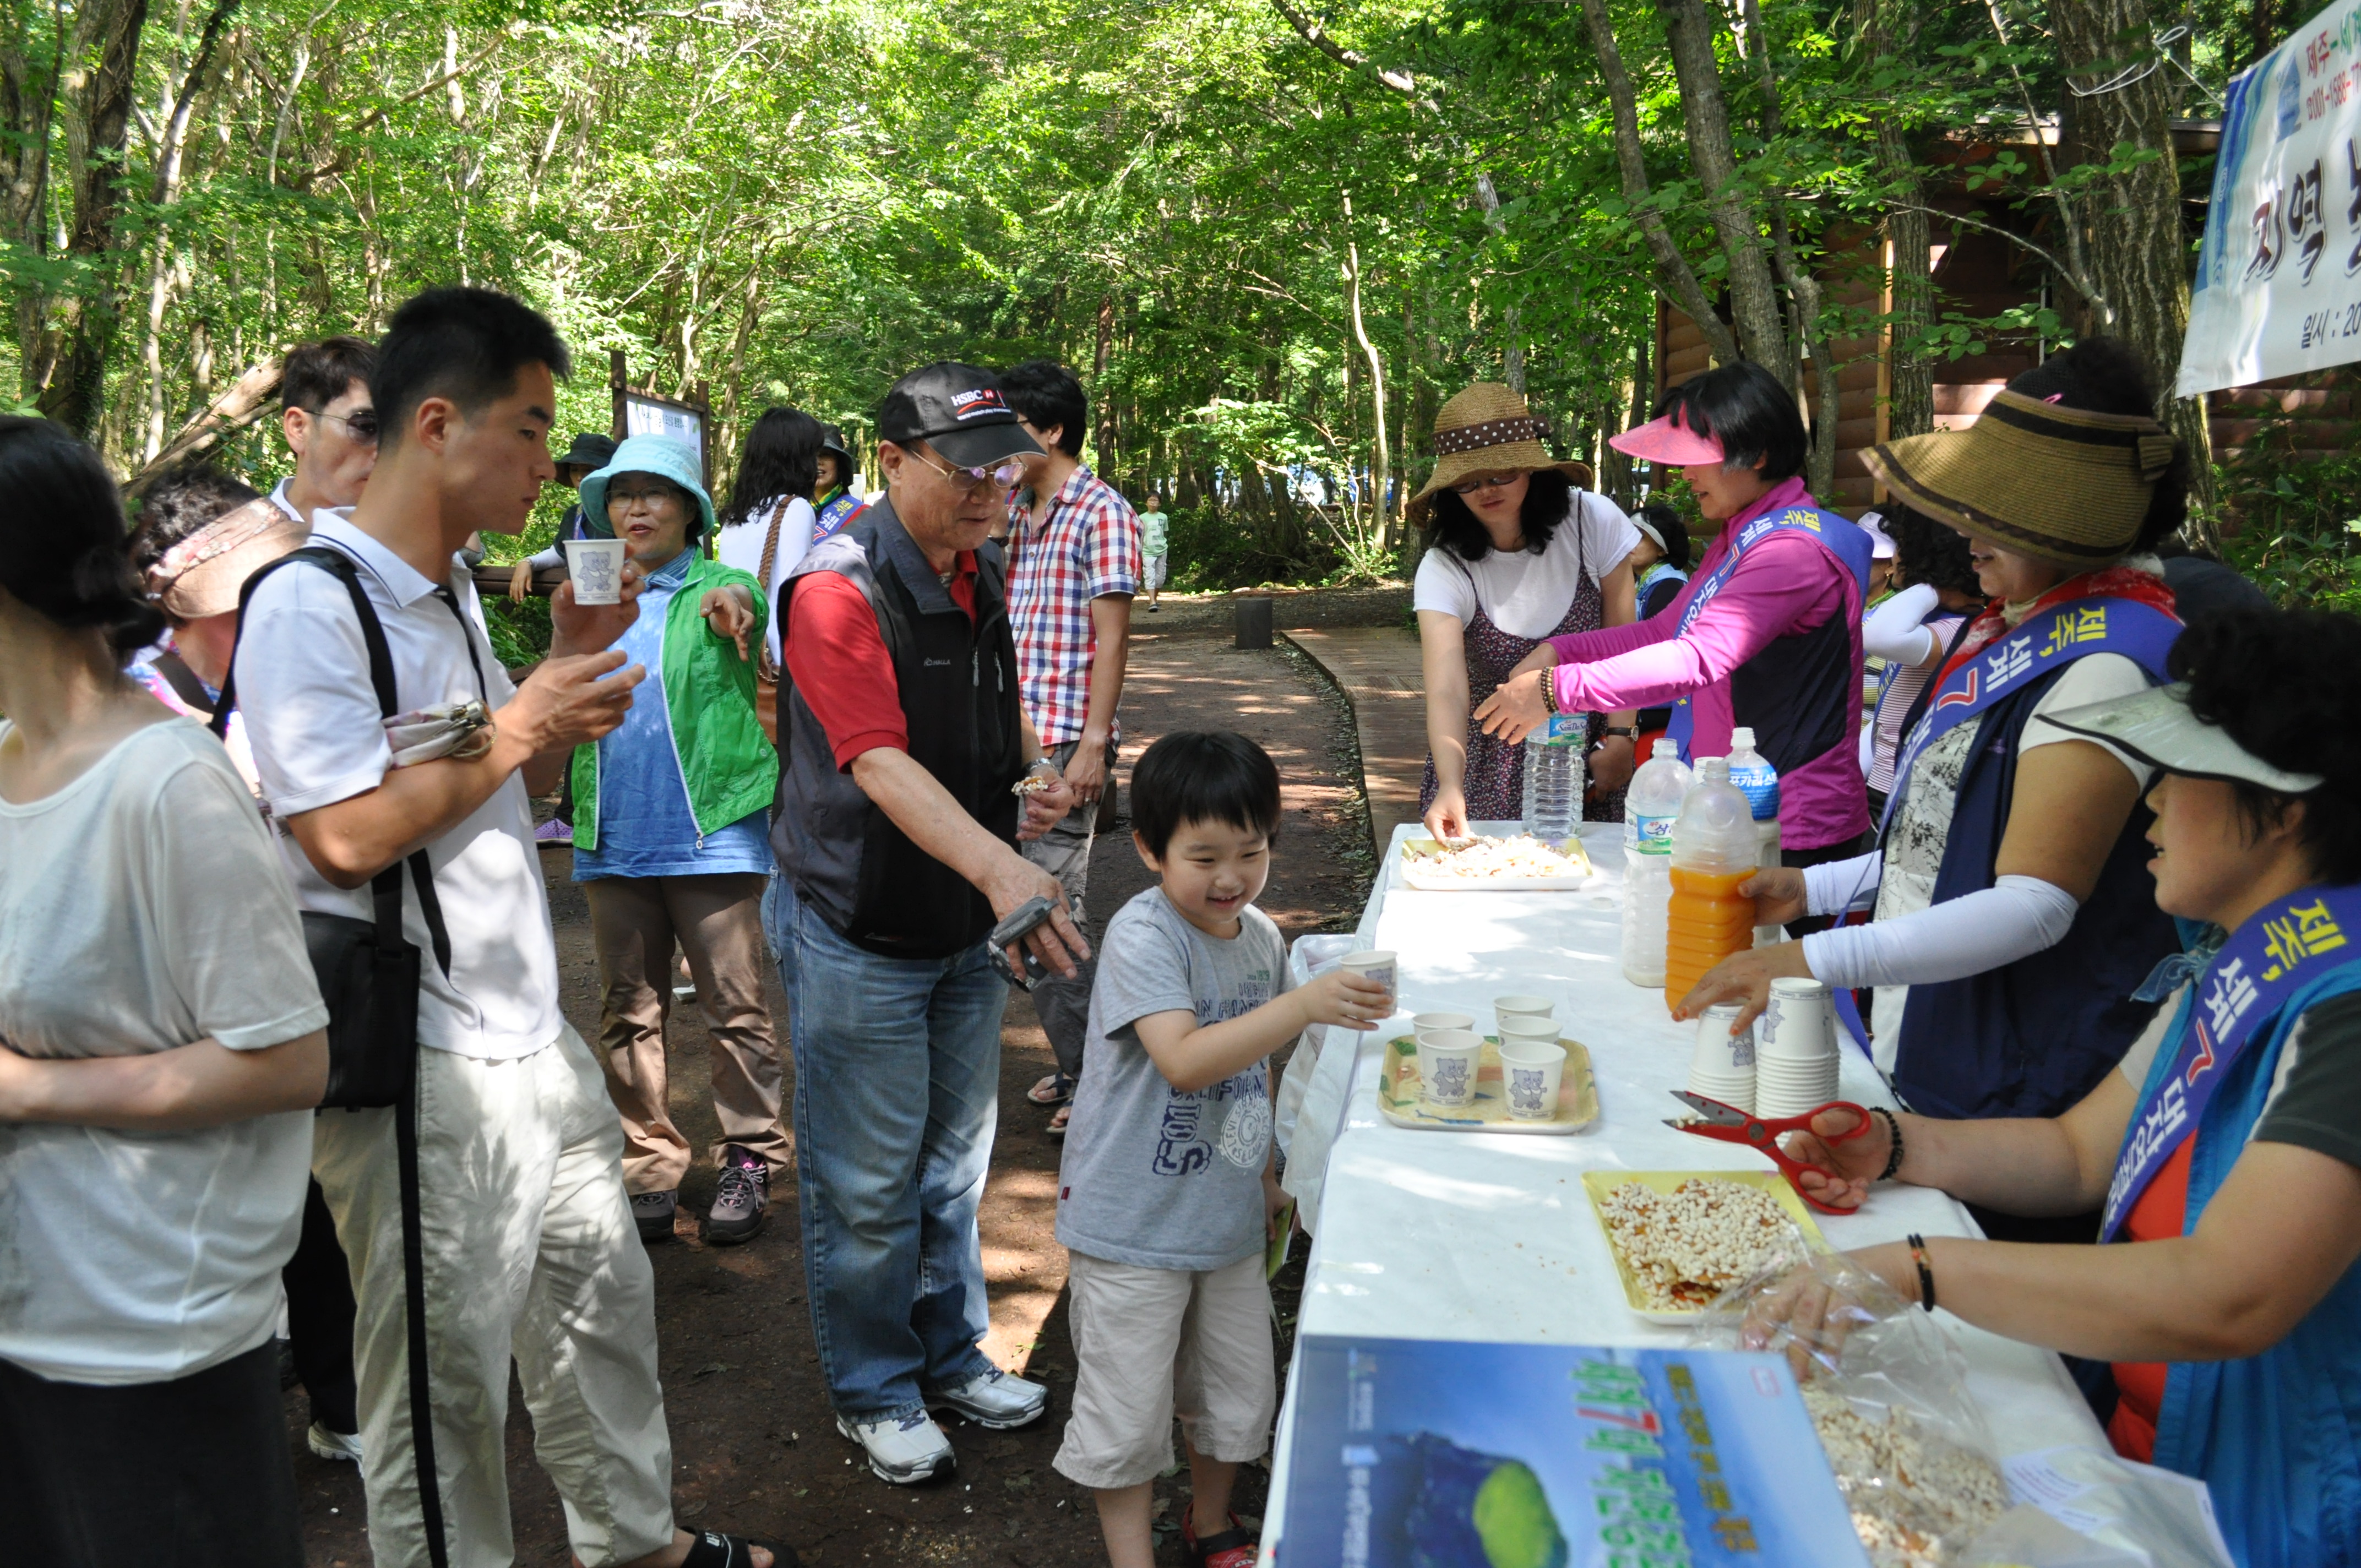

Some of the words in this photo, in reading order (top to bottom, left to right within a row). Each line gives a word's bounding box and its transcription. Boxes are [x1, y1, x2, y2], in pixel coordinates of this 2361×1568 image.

[2245, 158, 2326, 284] 지역
[2301, 309, 2330, 349] 일시
[950, 389, 983, 406] HSBC
[1779, 510, 1821, 533] 제주,
[2039, 606, 2106, 657] 제주,
[2262, 899, 2347, 982] 제주,
[1152, 1104, 1212, 1176] 501
